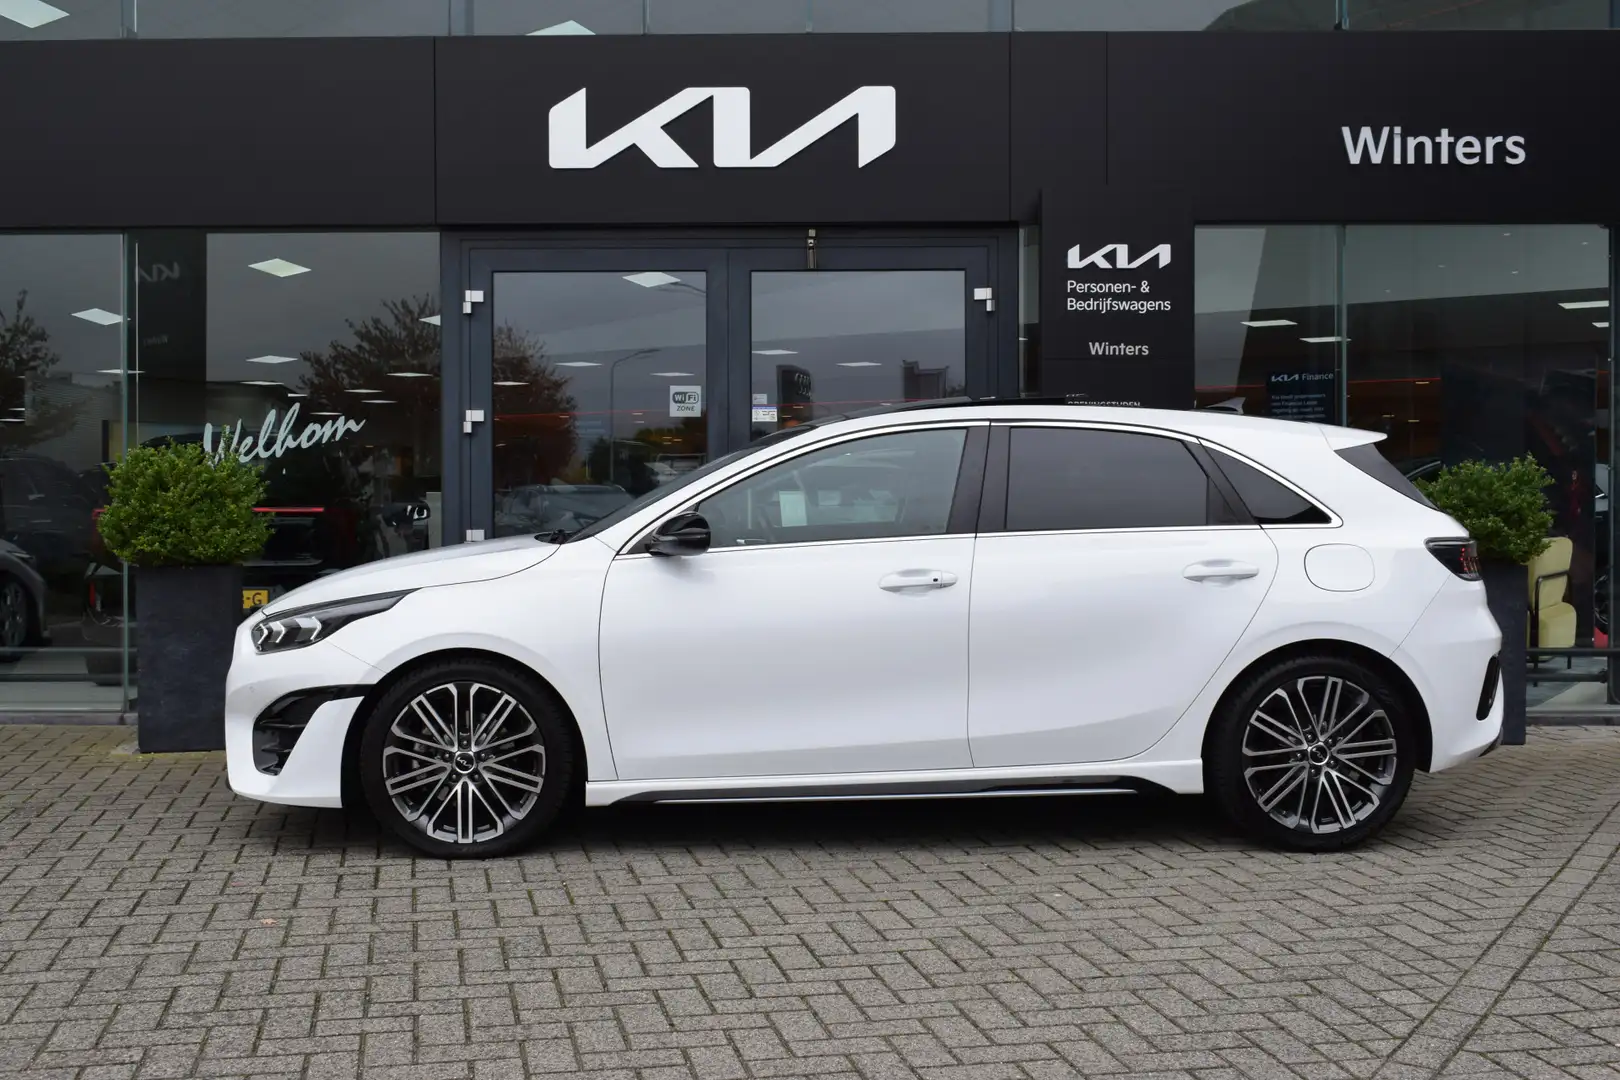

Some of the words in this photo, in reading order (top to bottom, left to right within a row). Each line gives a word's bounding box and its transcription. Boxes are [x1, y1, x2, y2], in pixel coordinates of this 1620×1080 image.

[548, 86, 896, 169] KIA
[1341, 126, 1526, 165] Winters
[1067, 243, 1171, 269] KIA
[1067, 280, 1137, 293] Personen-
[1140, 280, 1150, 293] &
[1067, 297, 1171, 314] Bedrijfswagens
[1089, 341, 1150, 356] Winters
[1271, 373, 1299, 382] KIA
[1302, 372, 1334, 381] Finance
